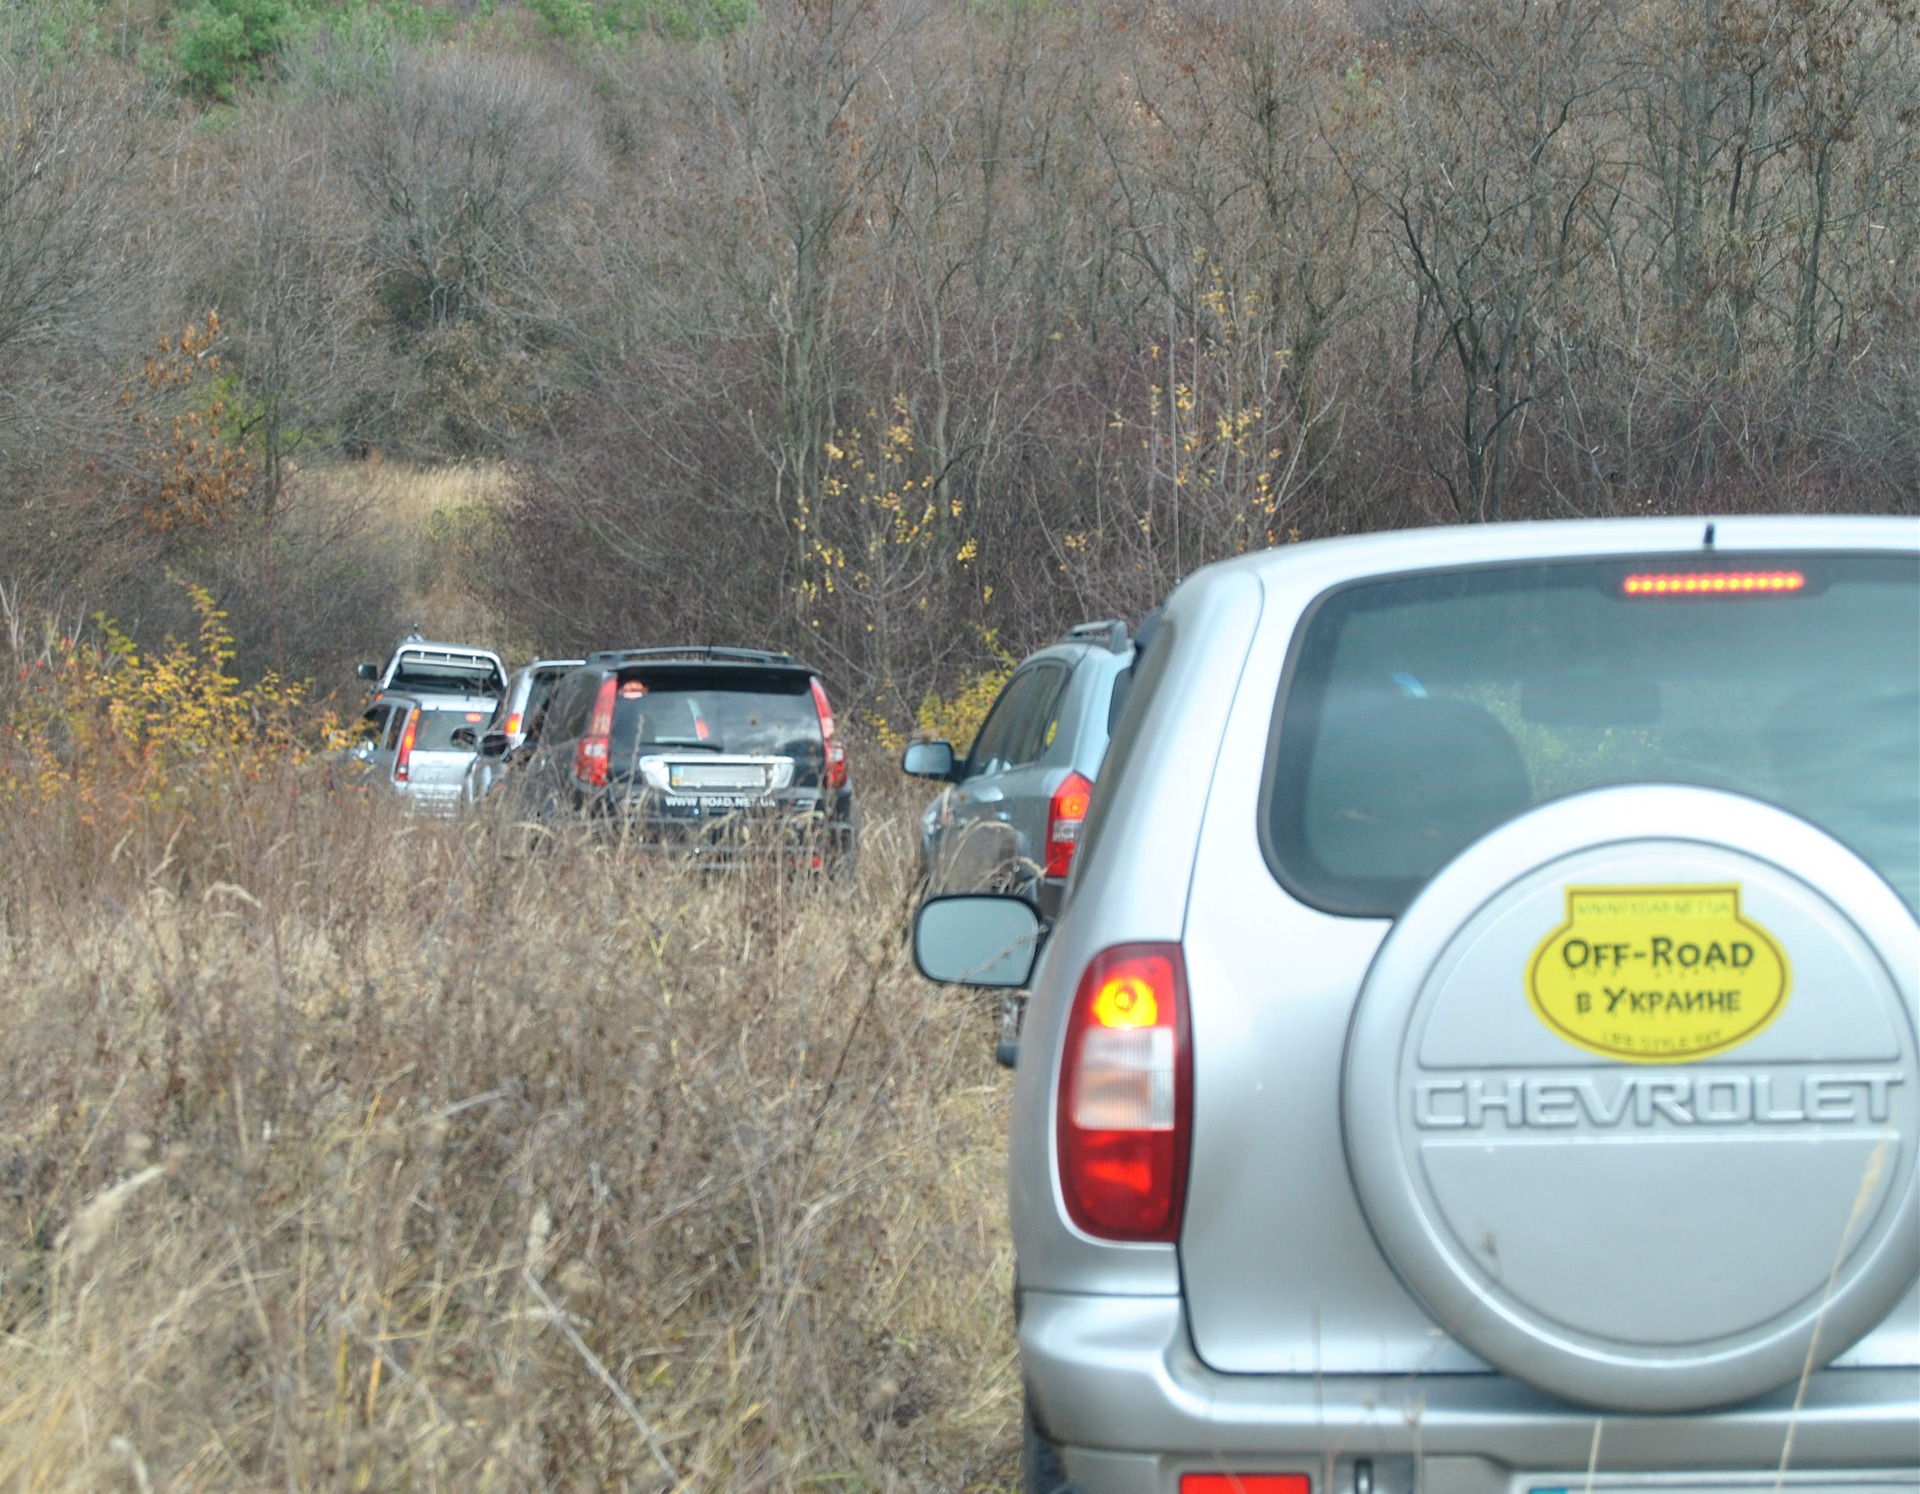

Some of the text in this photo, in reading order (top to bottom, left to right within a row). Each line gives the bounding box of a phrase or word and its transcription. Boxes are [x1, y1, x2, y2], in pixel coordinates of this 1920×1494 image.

[1562, 936, 1755, 969] OFF-ROAD
[1603, 984, 1741, 1013] УКРАИНЕ
[1414, 1074, 1905, 1128] CHEVROLET
